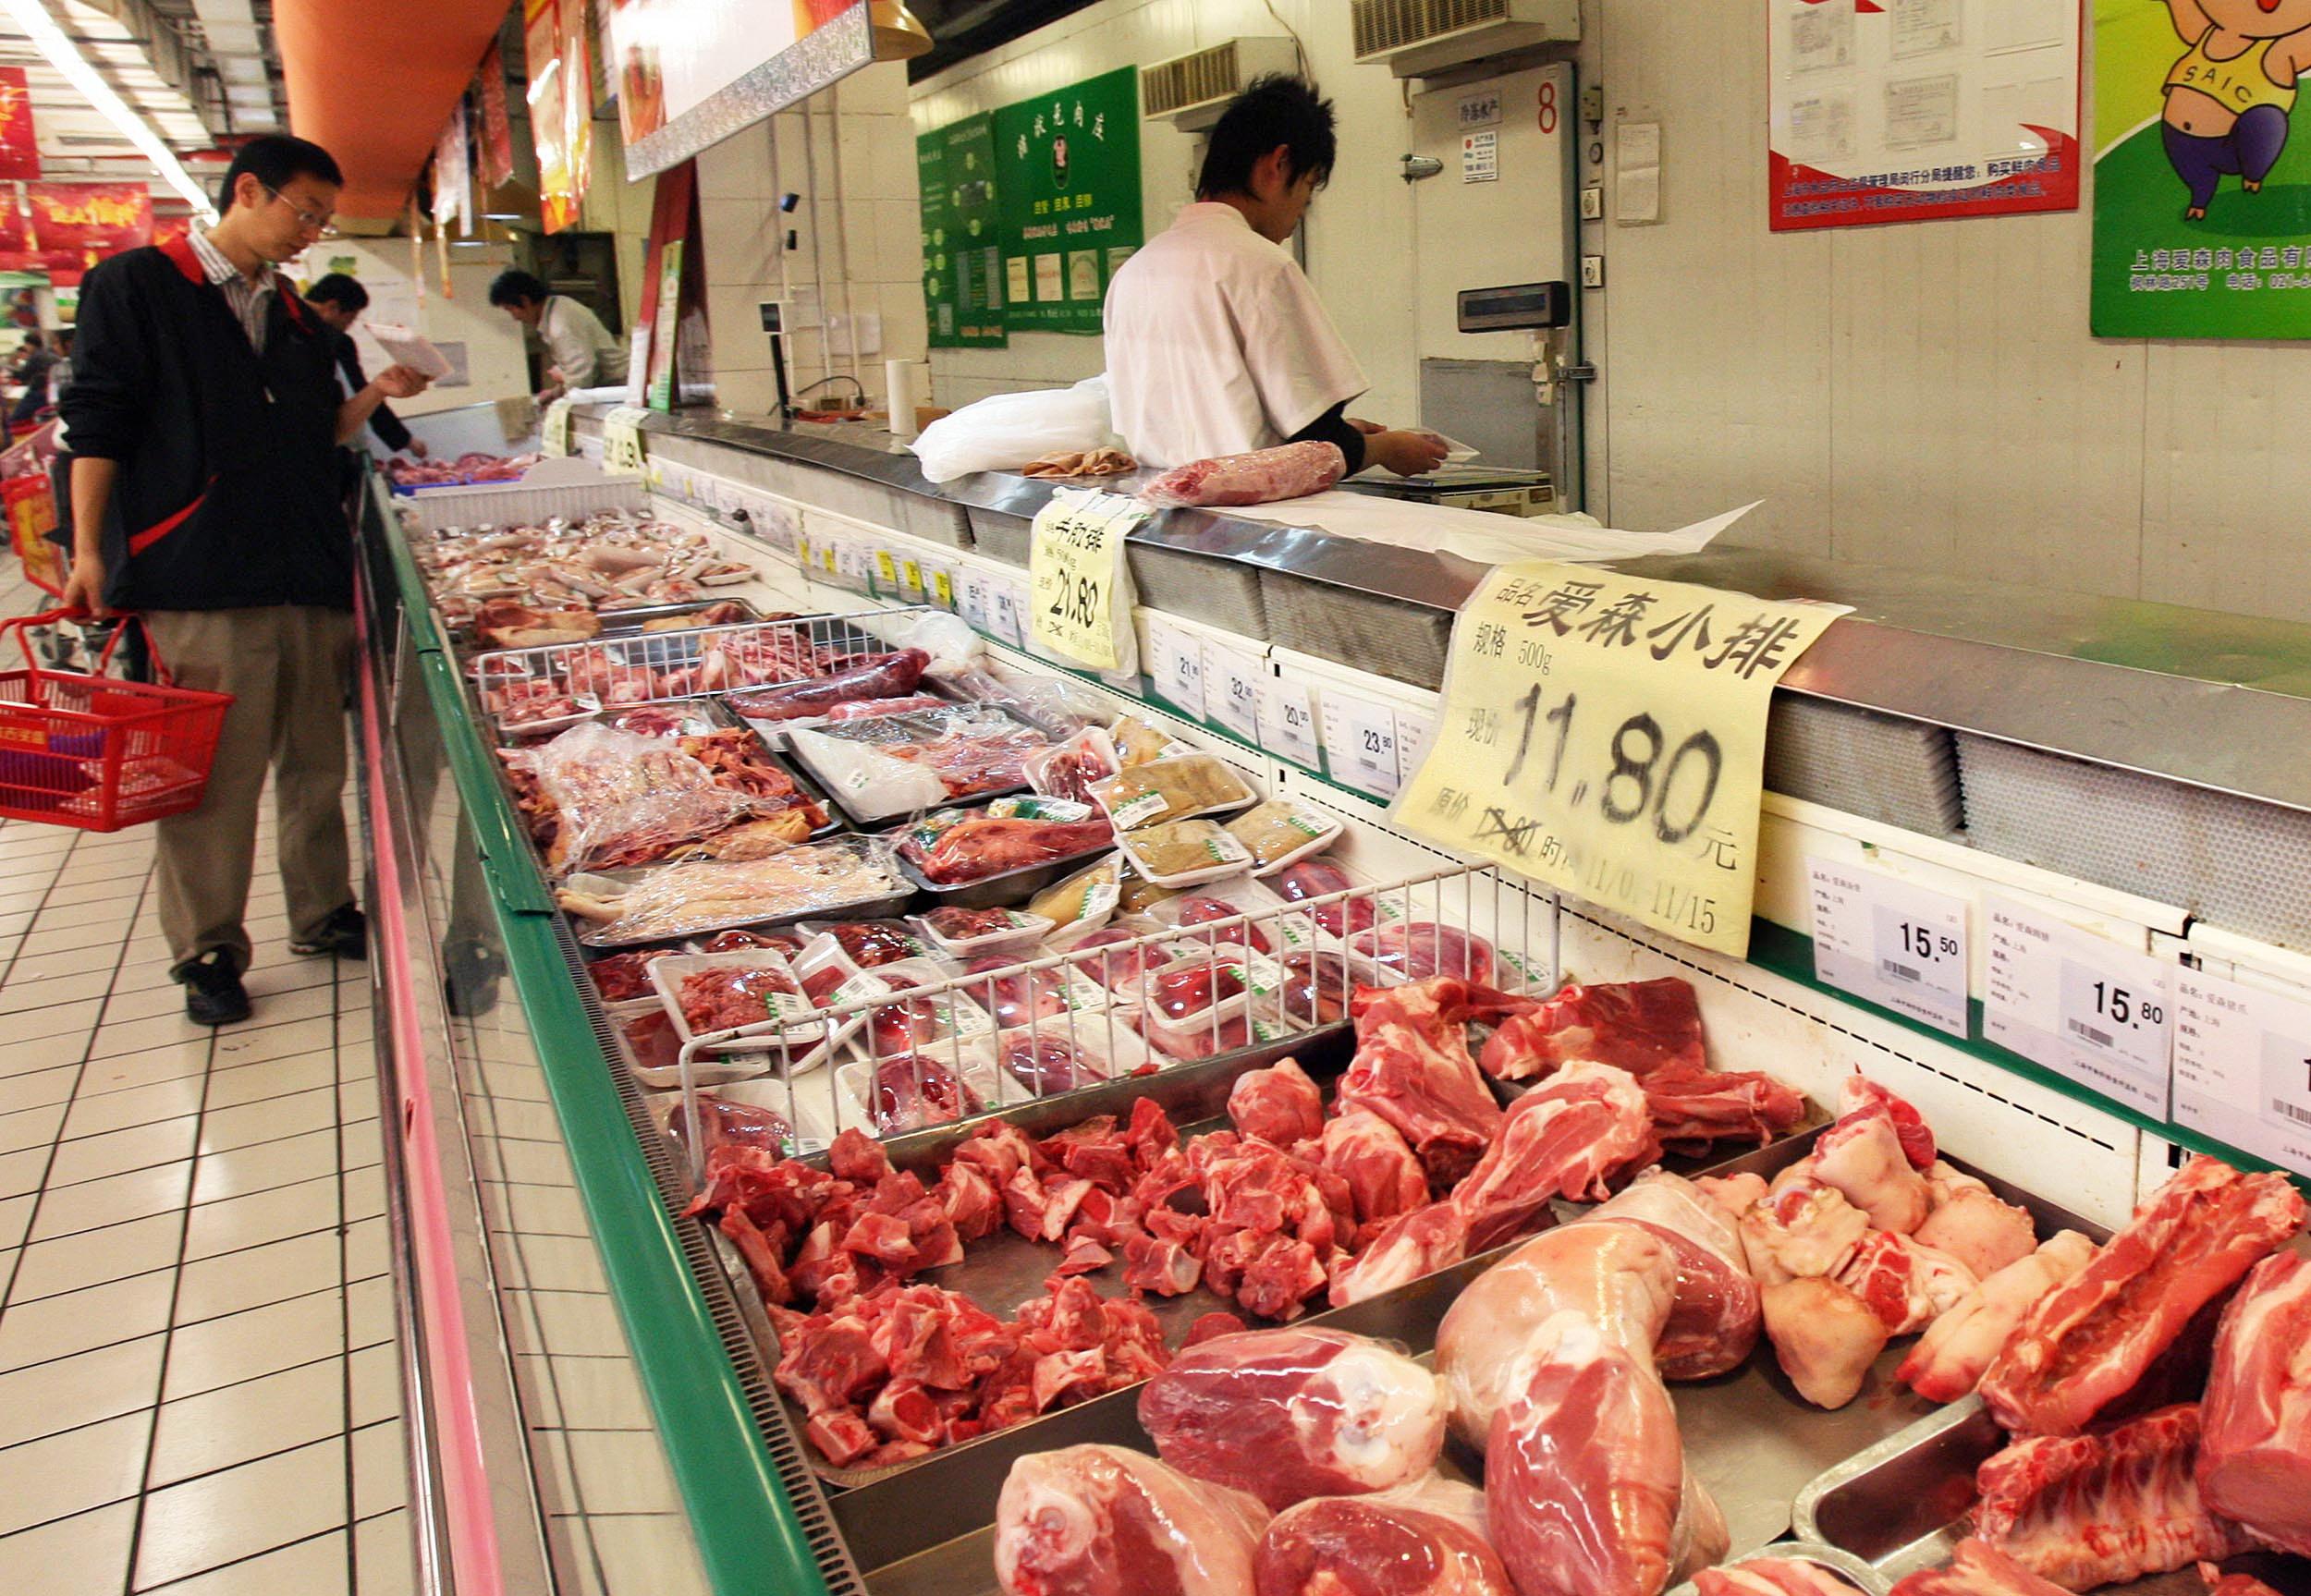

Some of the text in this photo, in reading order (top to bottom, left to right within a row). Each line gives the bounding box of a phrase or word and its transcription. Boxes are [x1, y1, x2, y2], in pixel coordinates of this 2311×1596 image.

[1538, 81, 1557, 134] 8
[2183, 66, 2253, 104] SAIC
[1050, 567, 1098, 628] 21.80
[1473, 620, 1553, 676] 规格 500g
[1497, 578, 1801, 680] 品名 爱森小排
[1504, 681, 1722, 845] 11.80
[1697, 826, 1739, 871] 元
[1900, 922, 1958, 963] 15.50
[2093, 981, 2163, 1029] 15.80
